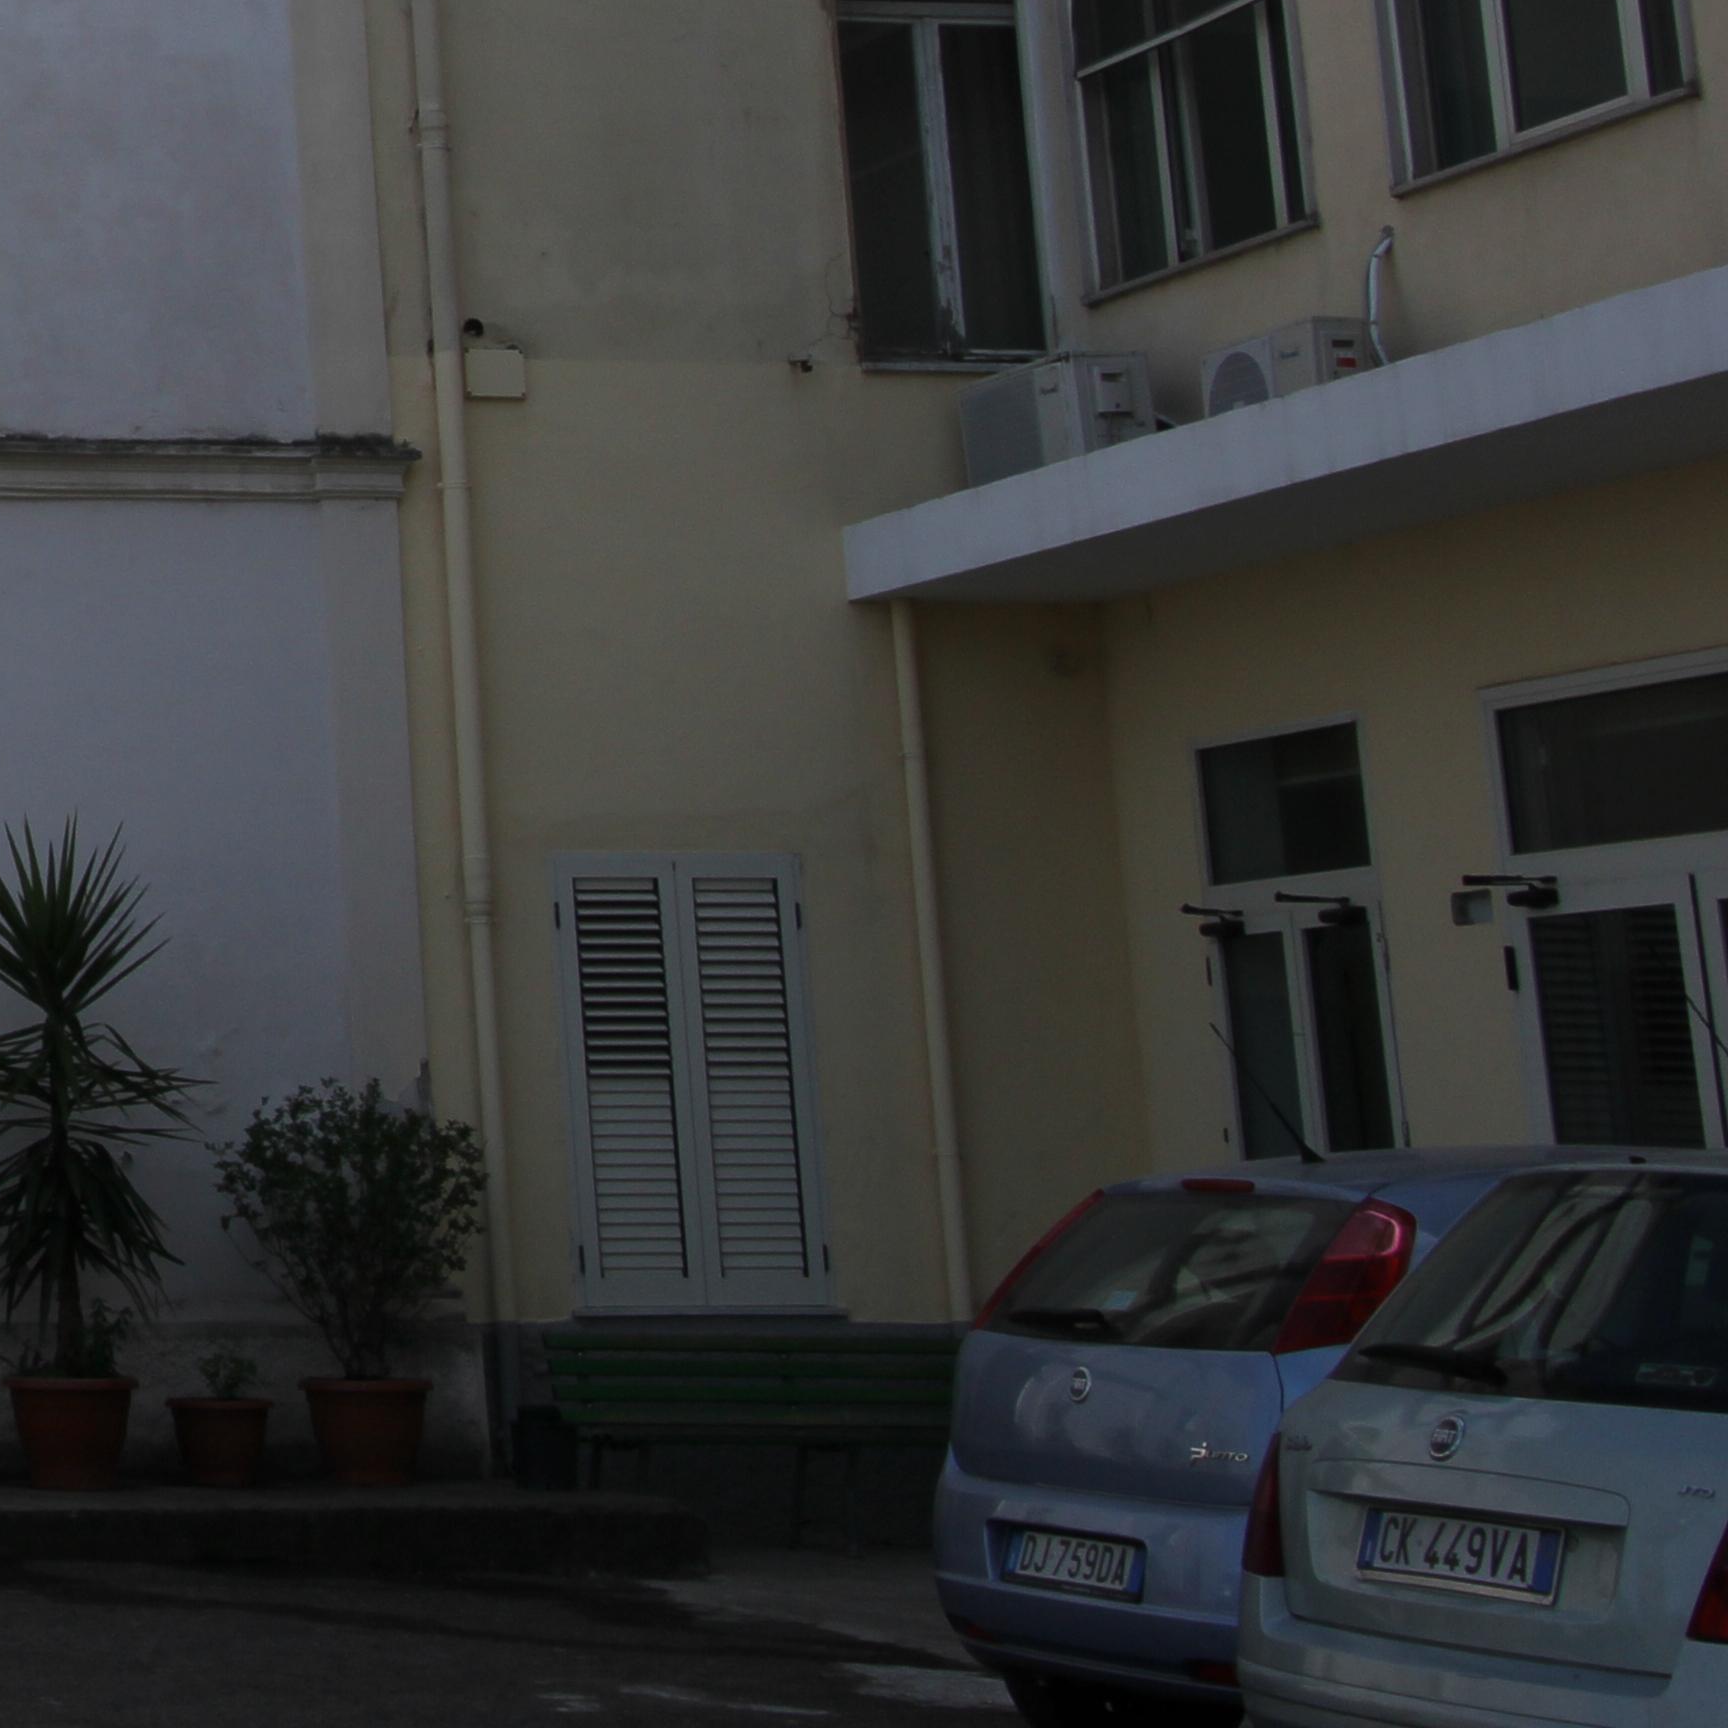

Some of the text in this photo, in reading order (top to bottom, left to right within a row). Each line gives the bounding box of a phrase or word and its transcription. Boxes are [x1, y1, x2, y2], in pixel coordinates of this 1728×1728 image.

[1019, 1533, 1052, 1573] DJ
[1052, 1537, 1128, 1587] 759DA
[1379, 1516, 1528, 1584] CK 449VA
